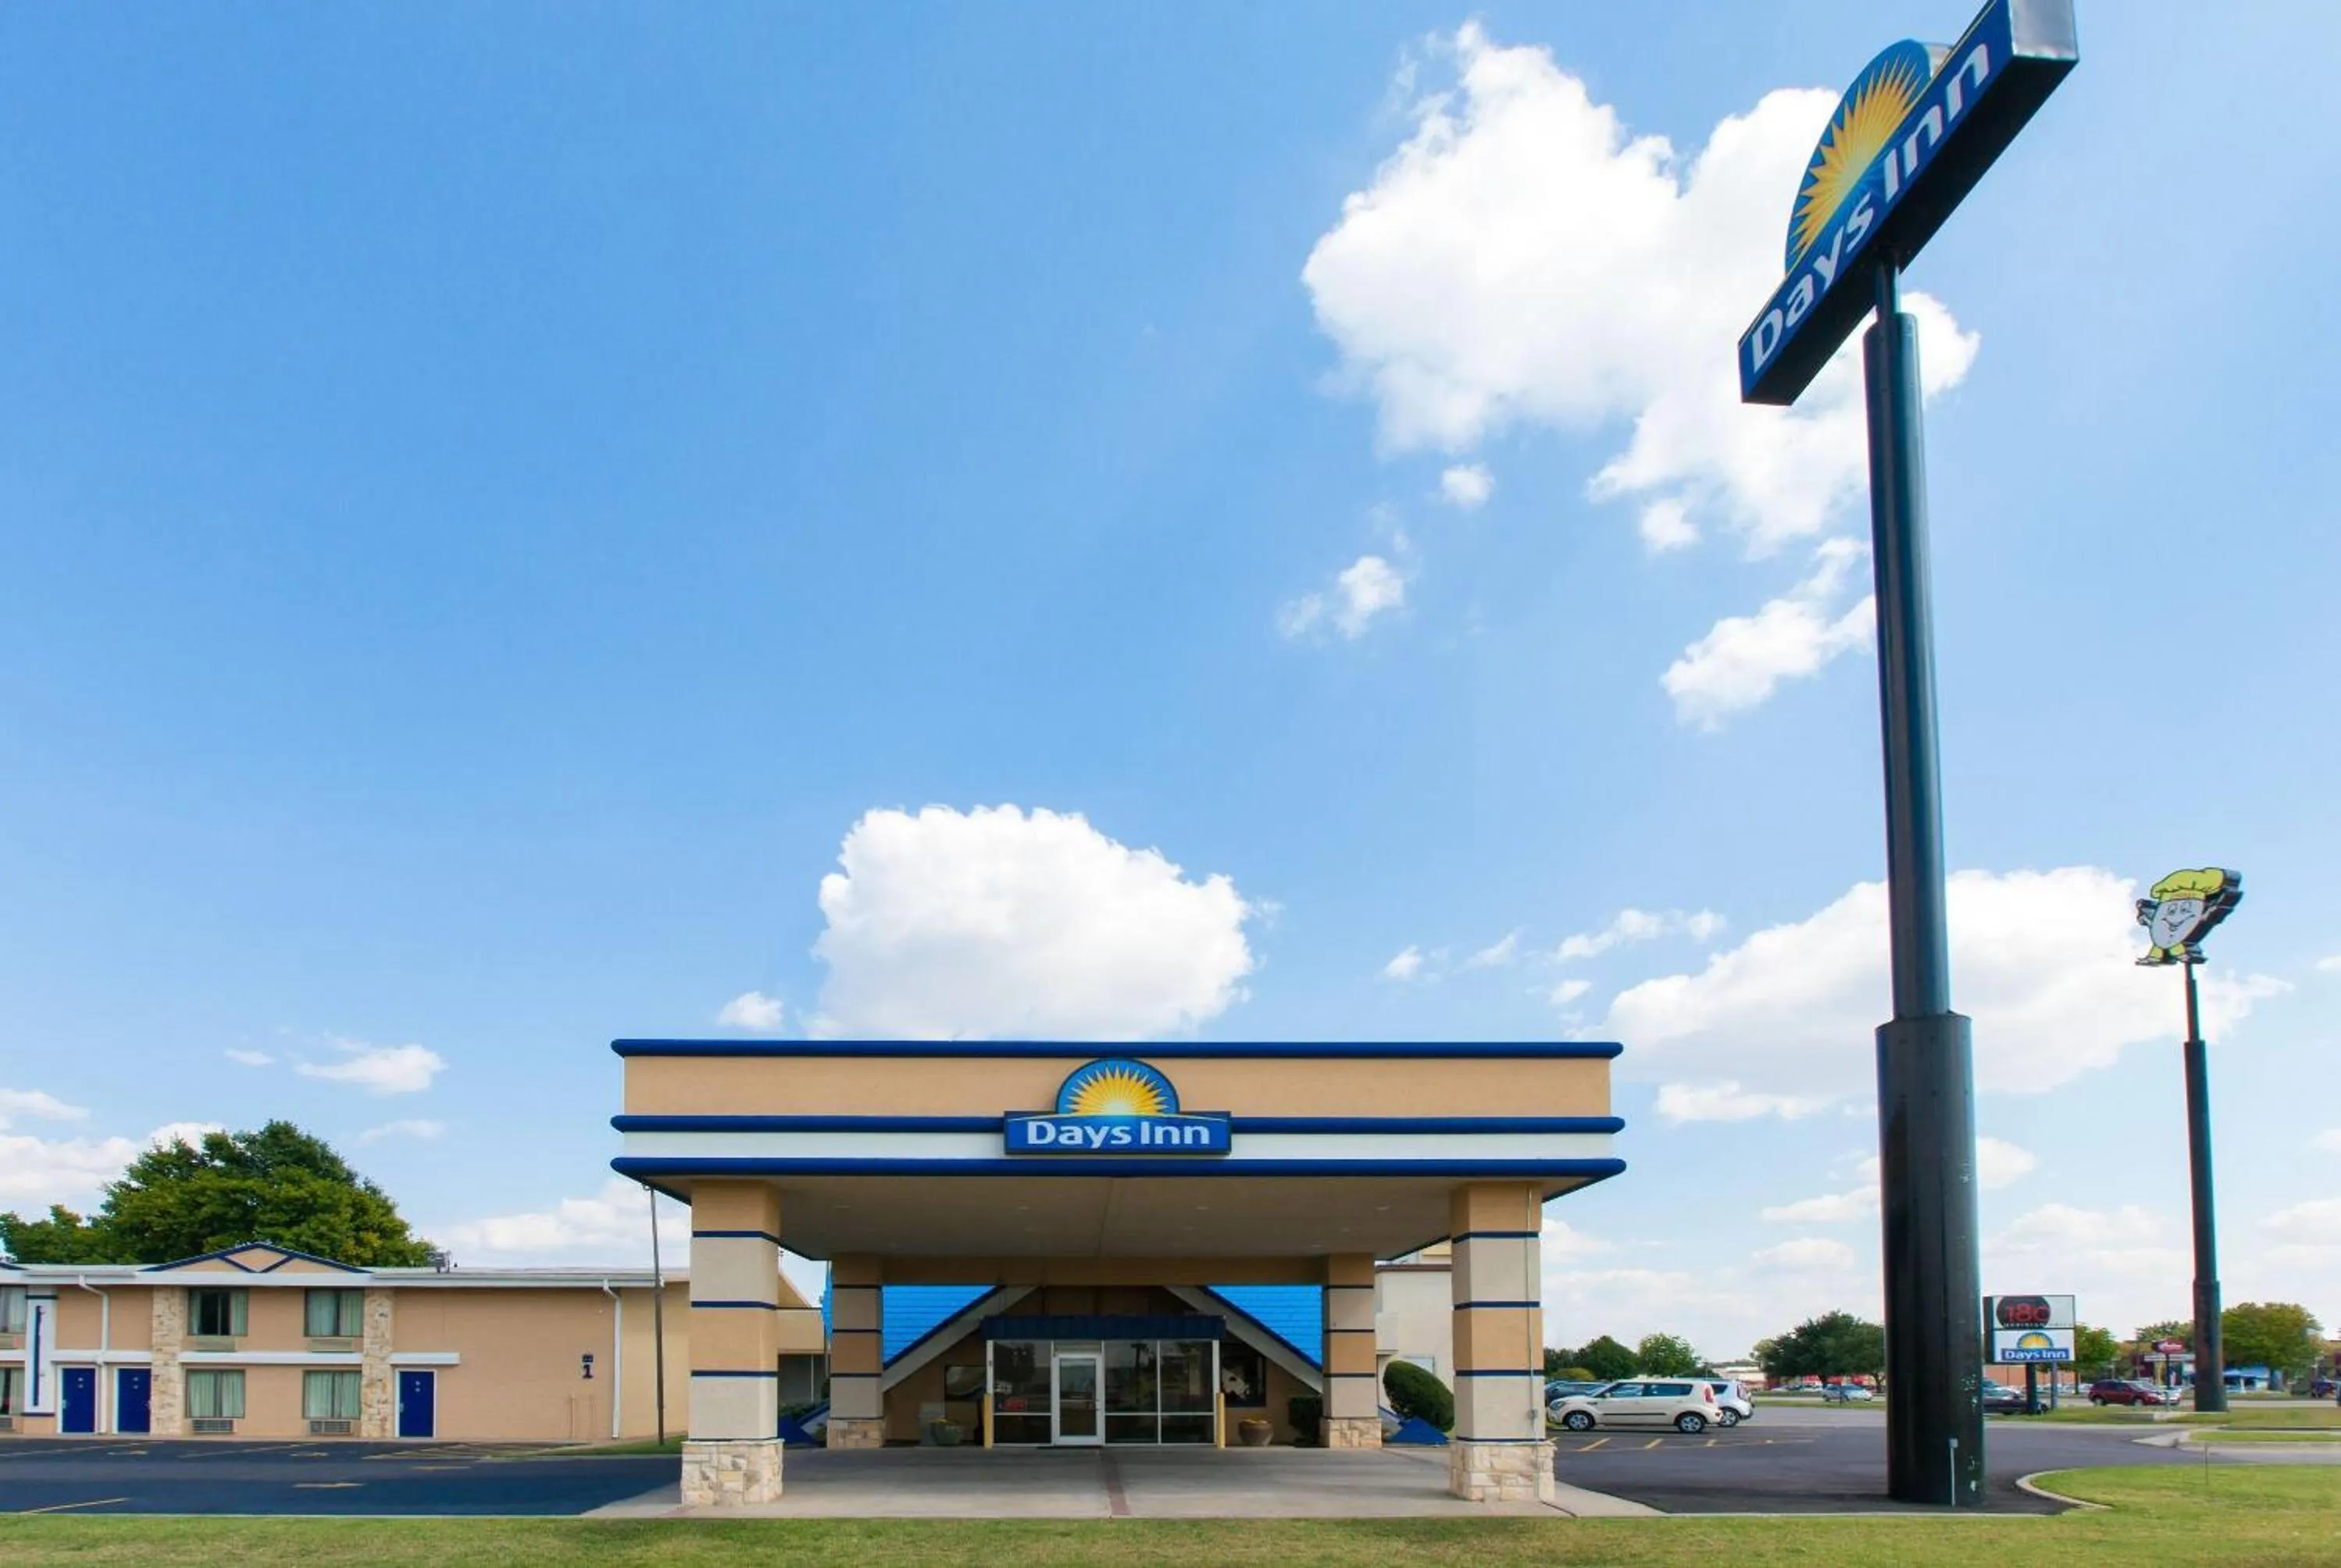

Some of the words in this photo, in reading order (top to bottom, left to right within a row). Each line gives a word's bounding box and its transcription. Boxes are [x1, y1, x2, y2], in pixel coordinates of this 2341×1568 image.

[1753, 192, 1874, 373] Days
[1884, 43, 1990, 203] Inn
[1027, 1121, 1132, 1149] Days
[1140, 1121, 1210, 1145] Inn
[2004, 1350, 2040, 1360] Days
[2042, 1350, 2067, 1360] Inn
